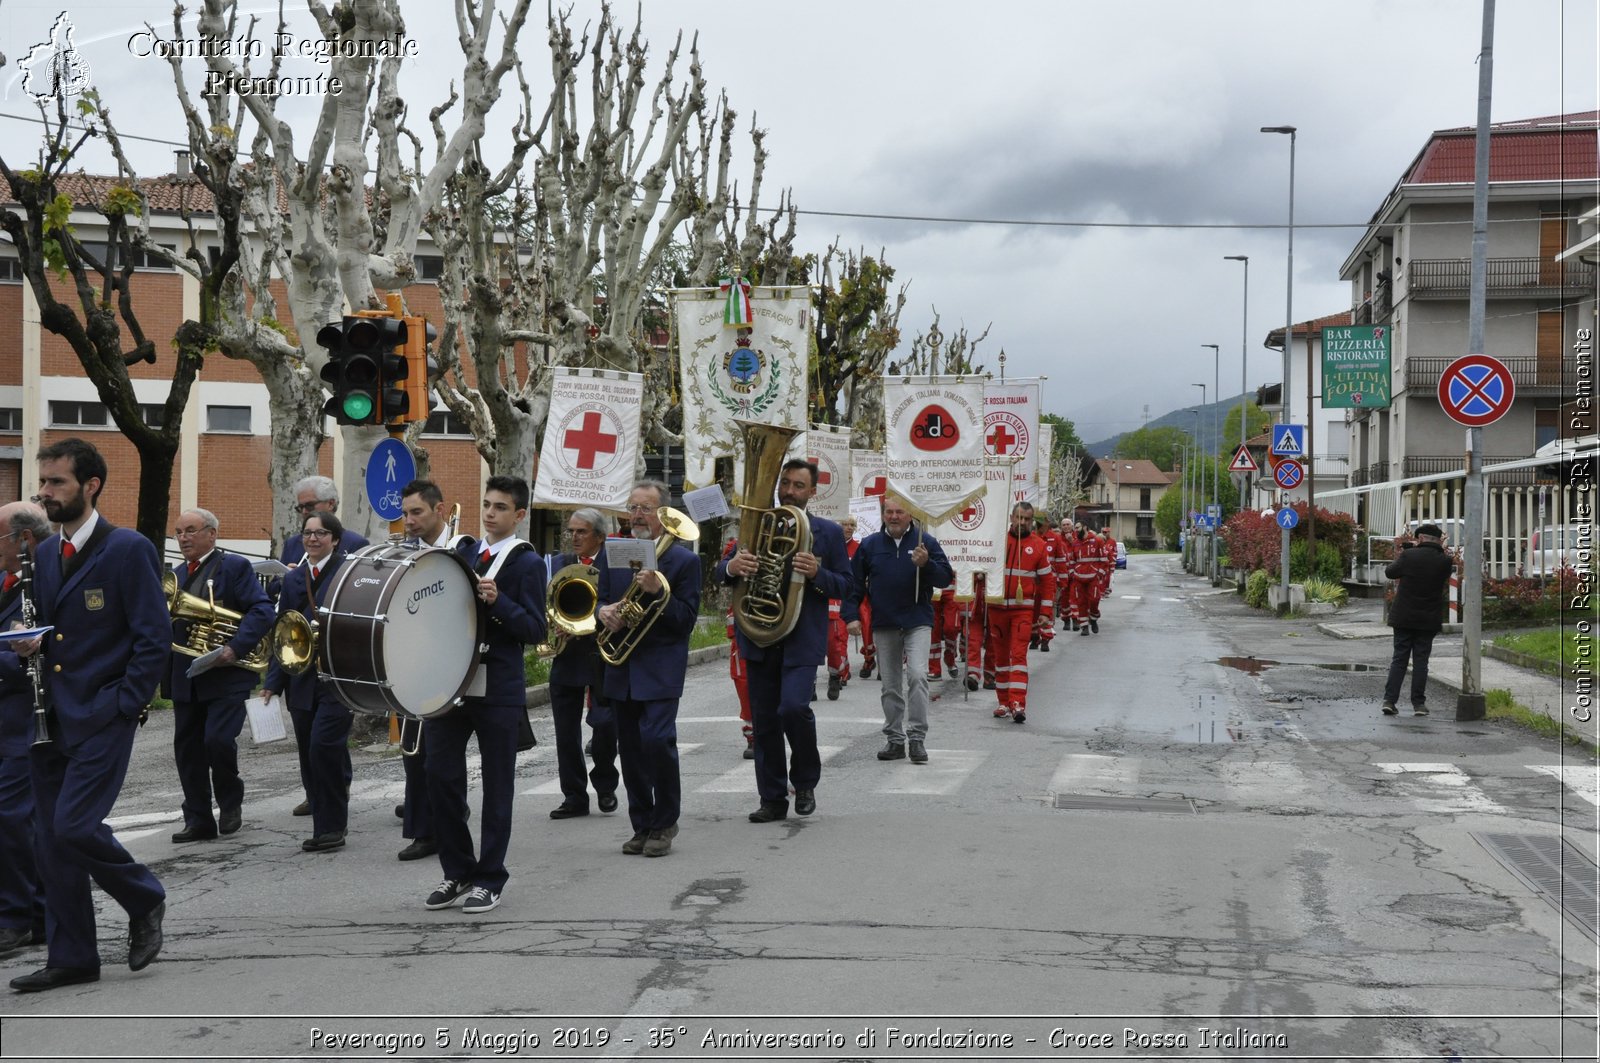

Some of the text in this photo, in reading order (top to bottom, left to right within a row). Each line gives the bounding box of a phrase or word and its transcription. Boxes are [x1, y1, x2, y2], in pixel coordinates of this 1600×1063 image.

[750, 307, 794, 326] EVERAGNO
[1327, 329, 1352, 340] BAR
[1327, 339, 1386, 350] PIZZERIA
[1327, 350, 1388, 361] RISTORANTE
[602, 385, 611, 393] DEL
[915, 389, 940, 400] ITALIANA
[1326, 381, 1386, 402] FOLLIA
[553, 390, 640, 404] CROCE ROSSA ITALIANA
[990, 397, 1005, 405] ROSSA
[1006, 396, 1028, 405] ITALIANA
[888, 460, 919, 468] GRUPPO
[920, 458, 982, 468] INTERCOMUNALE
[888, 471, 916, 480] BOVES
[926, 471, 957, 480] CHIUSA
[960, 470, 983, 479] PESIO
[985, 470, 1005, 481] LIANA
[551, 478, 618, 493] DELEGAZIONE DI
[910, 484, 961, 493] PEVERAGNO
[552, 487, 613, 503] PEVERAGNO
[413, 579, 445, 602] amat
